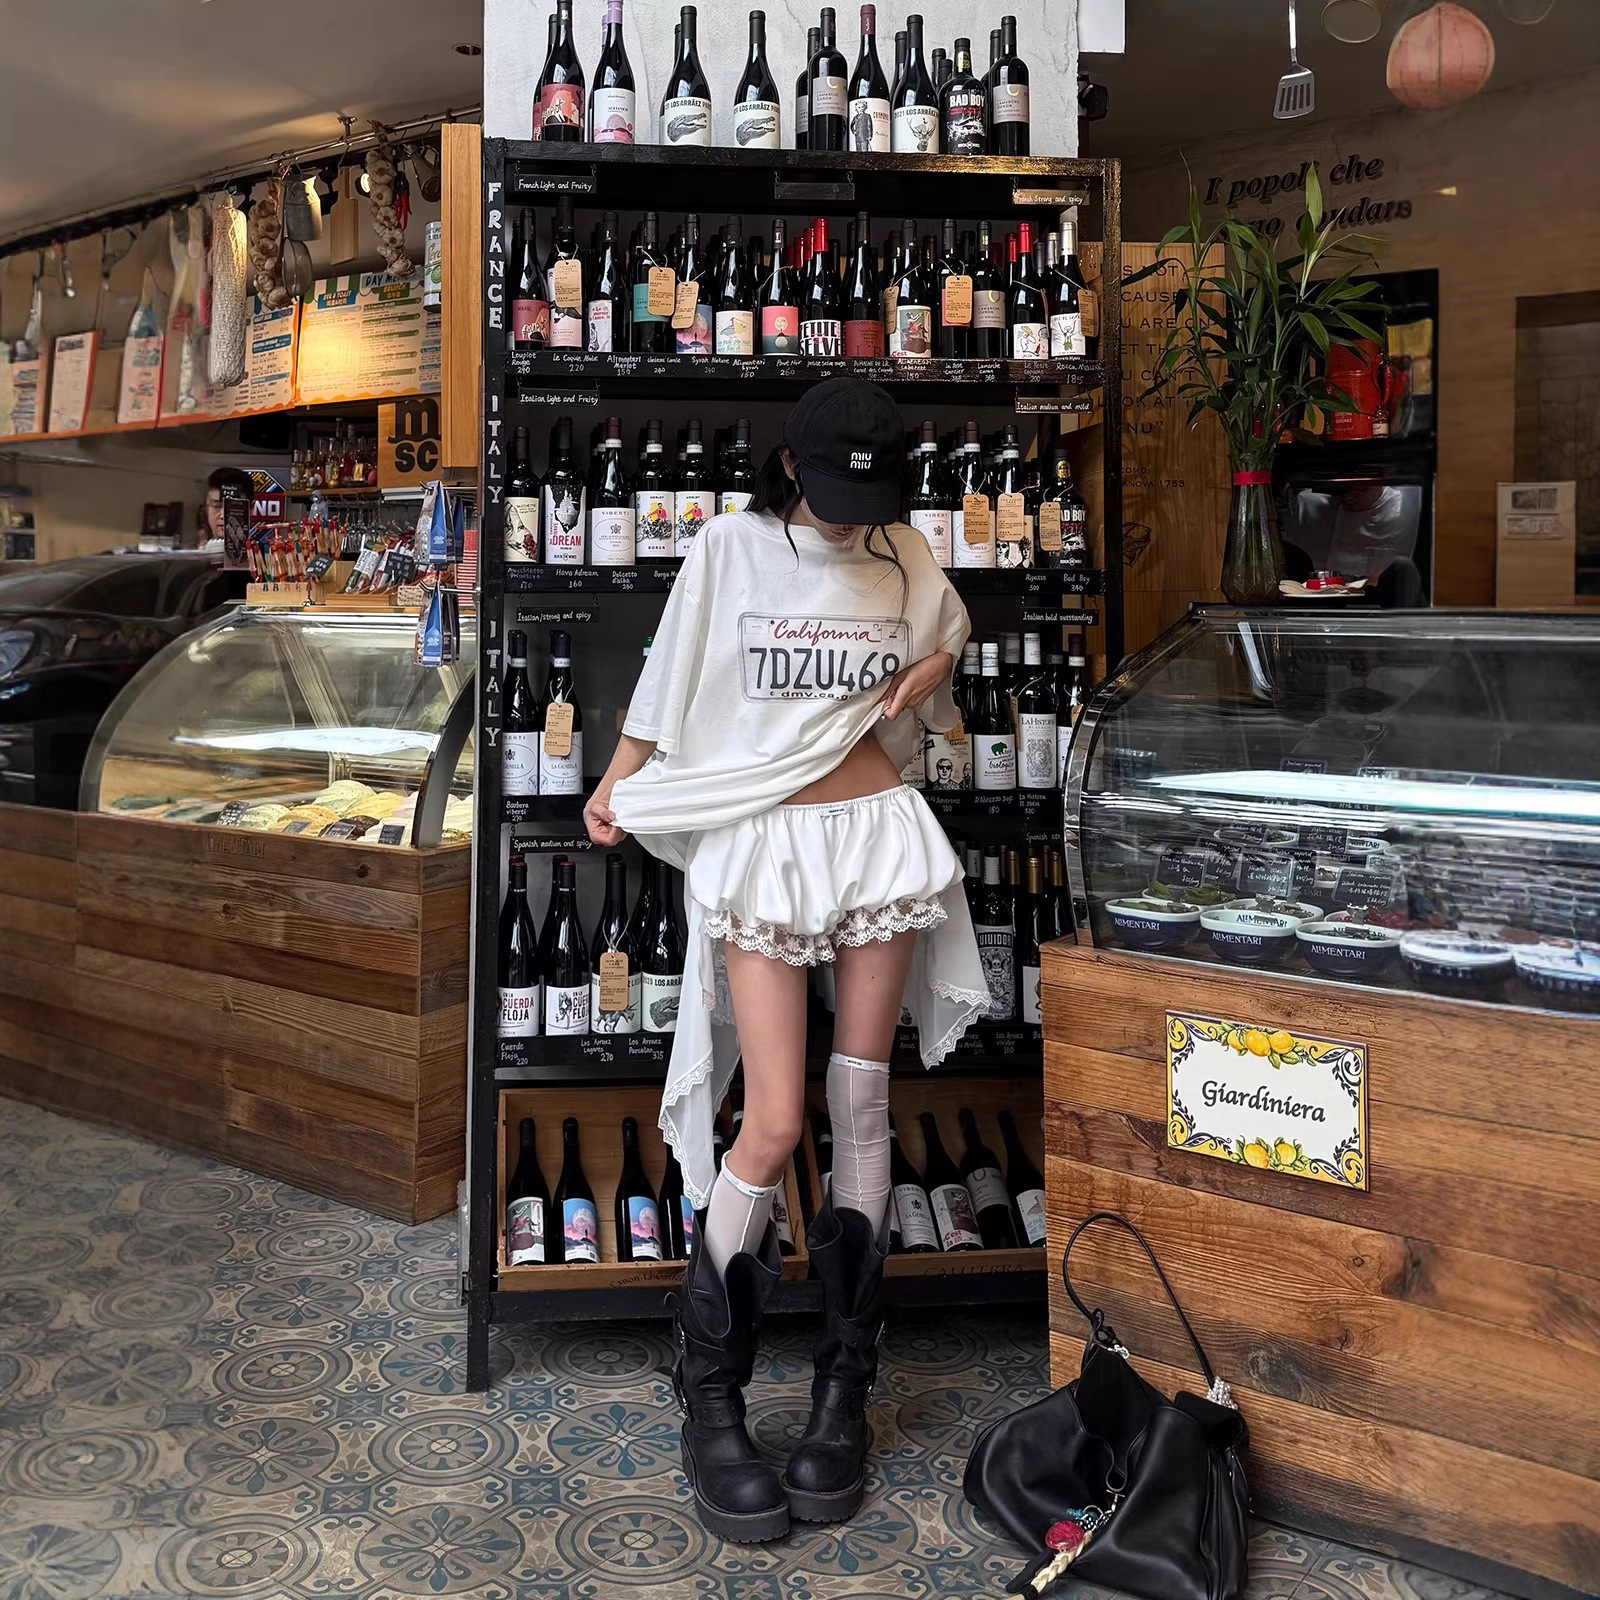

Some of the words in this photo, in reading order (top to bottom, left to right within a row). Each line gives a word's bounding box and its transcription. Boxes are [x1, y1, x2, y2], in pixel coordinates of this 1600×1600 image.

[949, 94, 968, 107] BAD
[969, 94, 985, 107] BOY
[1328, 153, 1386, 186] che
[557, 181, 570, 189] and
[571, 181, 592, 192] Fruity
[487, 181, 505, 332] FRANCE
[365, 274, 383, 287] DAY
[1139, 317, 1177, 330] ARE
[552, 353, 561, 362] Le
[568, 363, 585, 373] 220
[616, 368, 632, 377] 150
[1066, 373, 1084, 384] 185
[519, 393, 546, 403] Italian
[562, 394, 576, 403] and
[1152, 396, 1176, 408] AT
[1015, 401, 1038, 411] Italian
[1060, 402, 1073, 411] and
[486, 394, 504, 505] ITALY
[252, 499, 282, 517] NO
[1072, 509, 1087, 522] BOY
[552, 535, 582, 547] DREAM
[568, 579, 584, 589] 160
[1063, 572, 1076, 583] Bad
[1078, 573, 1091, 585] Boy
[1028, 584, 1041, 592] 500
[1070, 584, 1084, 593] 340
[562, 610, 575, 619] and
[1022, 611, 1045, 622] Italian
[773, 619, 882, 647] California
[485, 618, 503, 749] ITALY
[513, 839, 540, 853] Spanish
[562, 839, 575, 848] and
[502, 997, 535, 1010] CUERDA
[502, 1008, 531, 1022] FLOJA
[516, 1057, 529, 1066] 220
[600, 1052, 614, 1062] 270
[1201, 1080, 1327, 1123] Giardiniera
